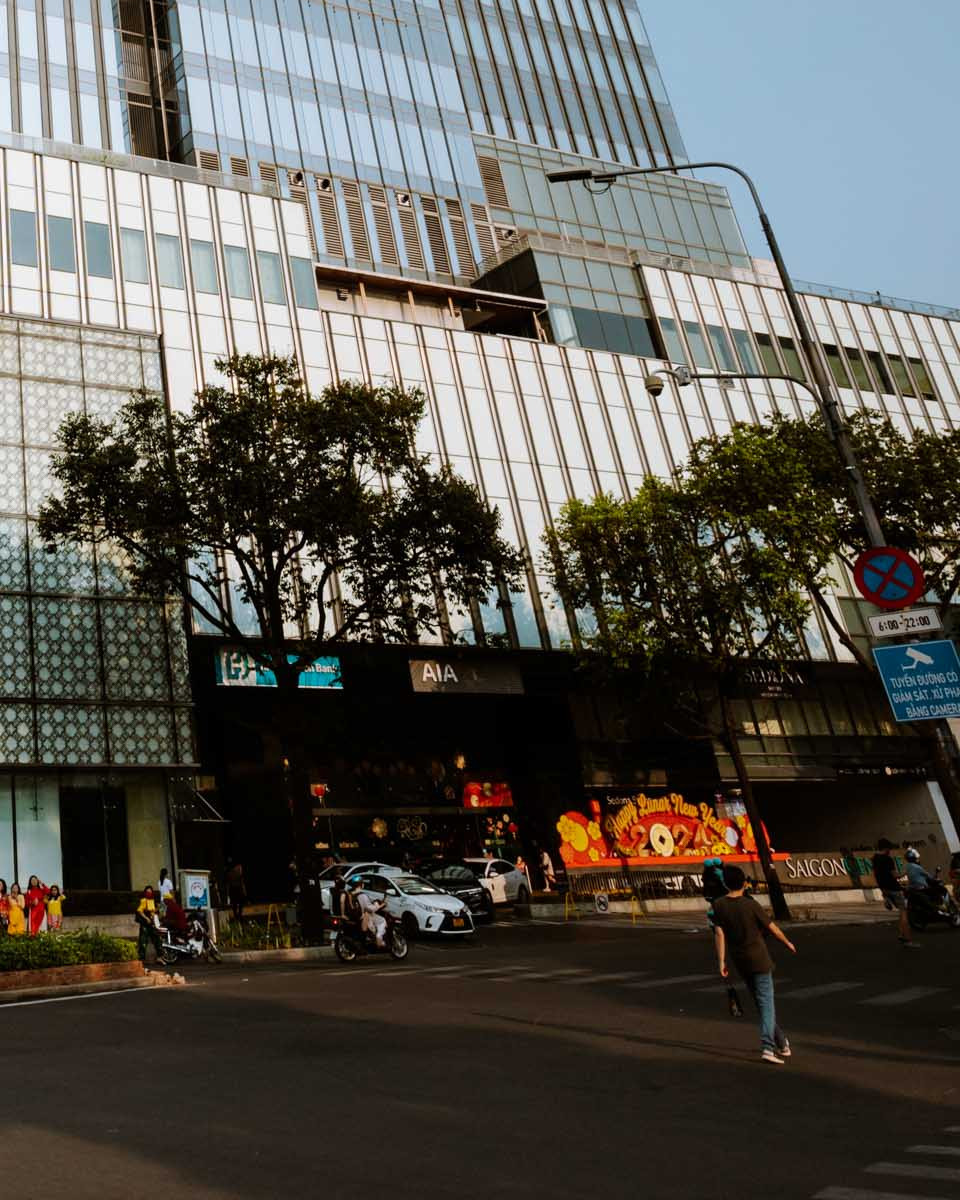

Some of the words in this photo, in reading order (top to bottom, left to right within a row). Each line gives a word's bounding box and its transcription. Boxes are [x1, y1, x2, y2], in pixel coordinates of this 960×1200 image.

[422, 663, 459, 683] AIA
[605, 800, 638, 839] Happy
[636, 793, 671, 816] Lunar
[670, 793, 699, 817] New
[699, 802, 726, 838] Year
